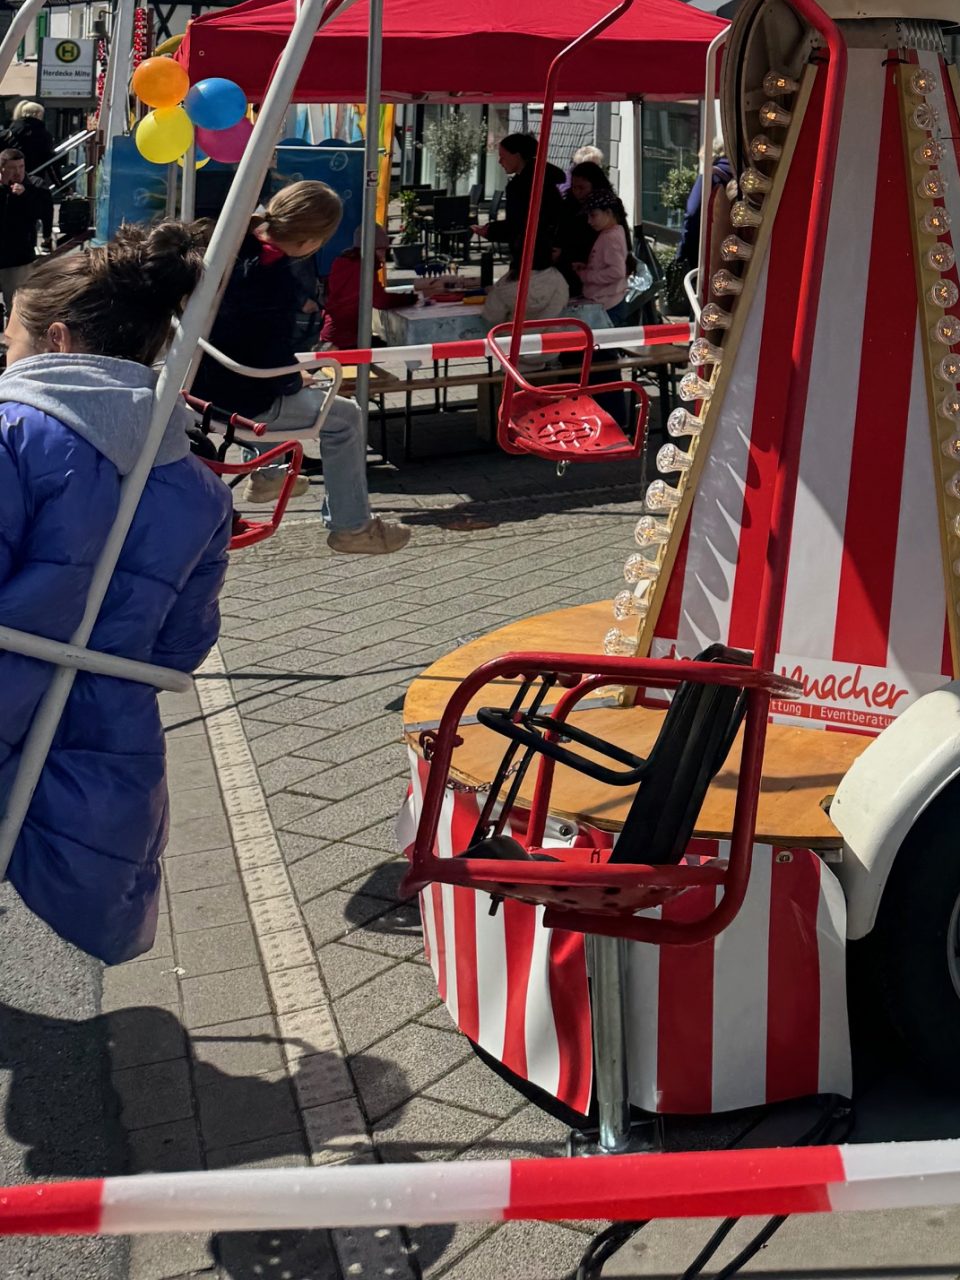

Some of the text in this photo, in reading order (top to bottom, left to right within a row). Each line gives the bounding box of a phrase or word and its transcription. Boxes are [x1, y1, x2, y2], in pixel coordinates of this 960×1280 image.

[43, 69, 91, 78] Herdecke Mitte
[770, 700, 802, 716] ttung
[820, 706, 895, 727] Eventberatu
